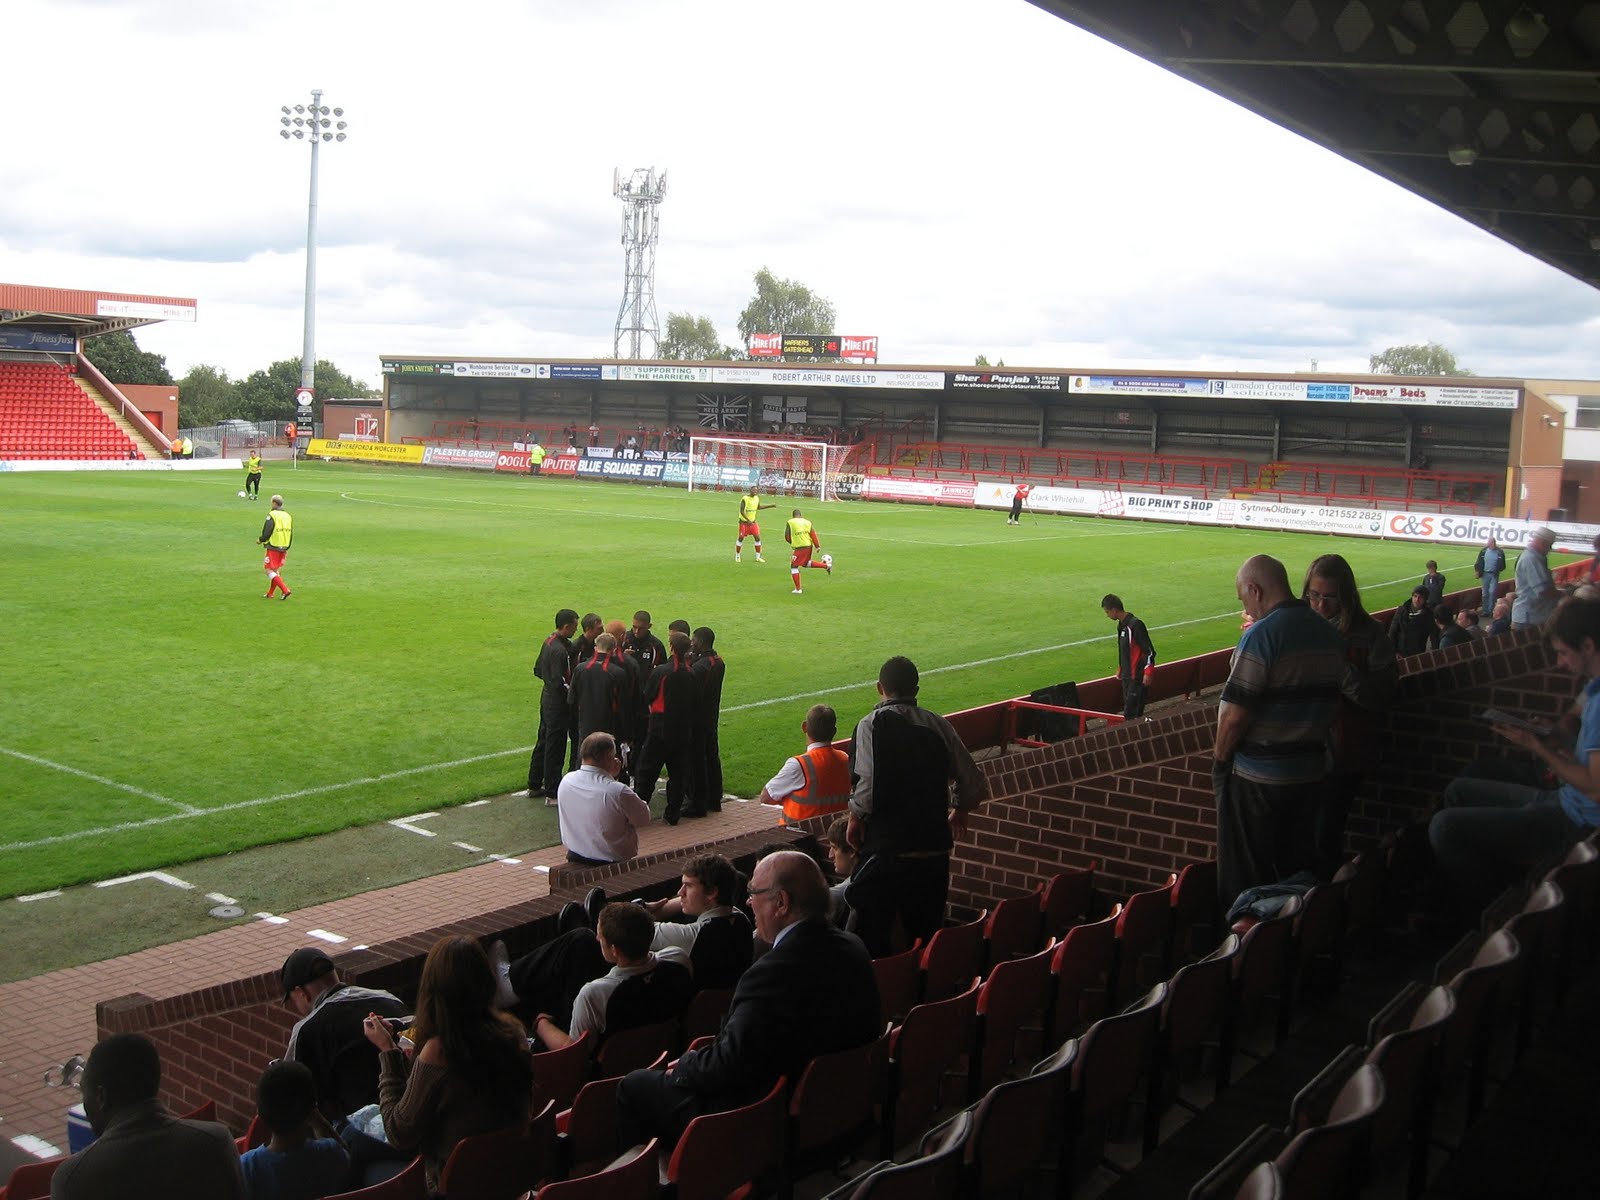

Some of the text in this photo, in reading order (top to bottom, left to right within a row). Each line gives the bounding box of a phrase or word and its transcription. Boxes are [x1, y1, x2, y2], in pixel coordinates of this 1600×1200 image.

[841, 337, 862, 351] HIRE
[637, 366, 692, 375] SUPPORTING
[772, 372, 877, 384] ROBERT ARTHUR DAVIES LTD
[954, 374, 1031, 385] Sher Punjab
[1225, 380, 1306, 393] Lumsdon Grindley
[1233, 389, 1295, 398] solicitors
[1400, 387, 1426, 398] Beds
[1436, 399, 1515, 409] www.dreamzbeds.co.uk
[374, 445, 407, 453] WORCESTER
[433, 448, 497, 459] PLESTER GROUP
[526, 457, 576, 471] CMPUTER
[577, 460, 664, 477] BLUE SQUARE BET
[785, 470, 806, 481] HARD
[848, 474, 863, 484] LTD
[794, 484, 818, 492] MAKE
[942, 486, 974, 496] LAWRENCE
[1031, 492, 1049, 502] Clark
[1128, 496, 1213, 511] BIG PRINT SHOP
[1271, 505, 1307, 517] Oldbury
[1318, 508, 1339, 517] 0121
[1359, 511, 1382, 521] 2825
[1389, 514, 1434, 537] C&S
